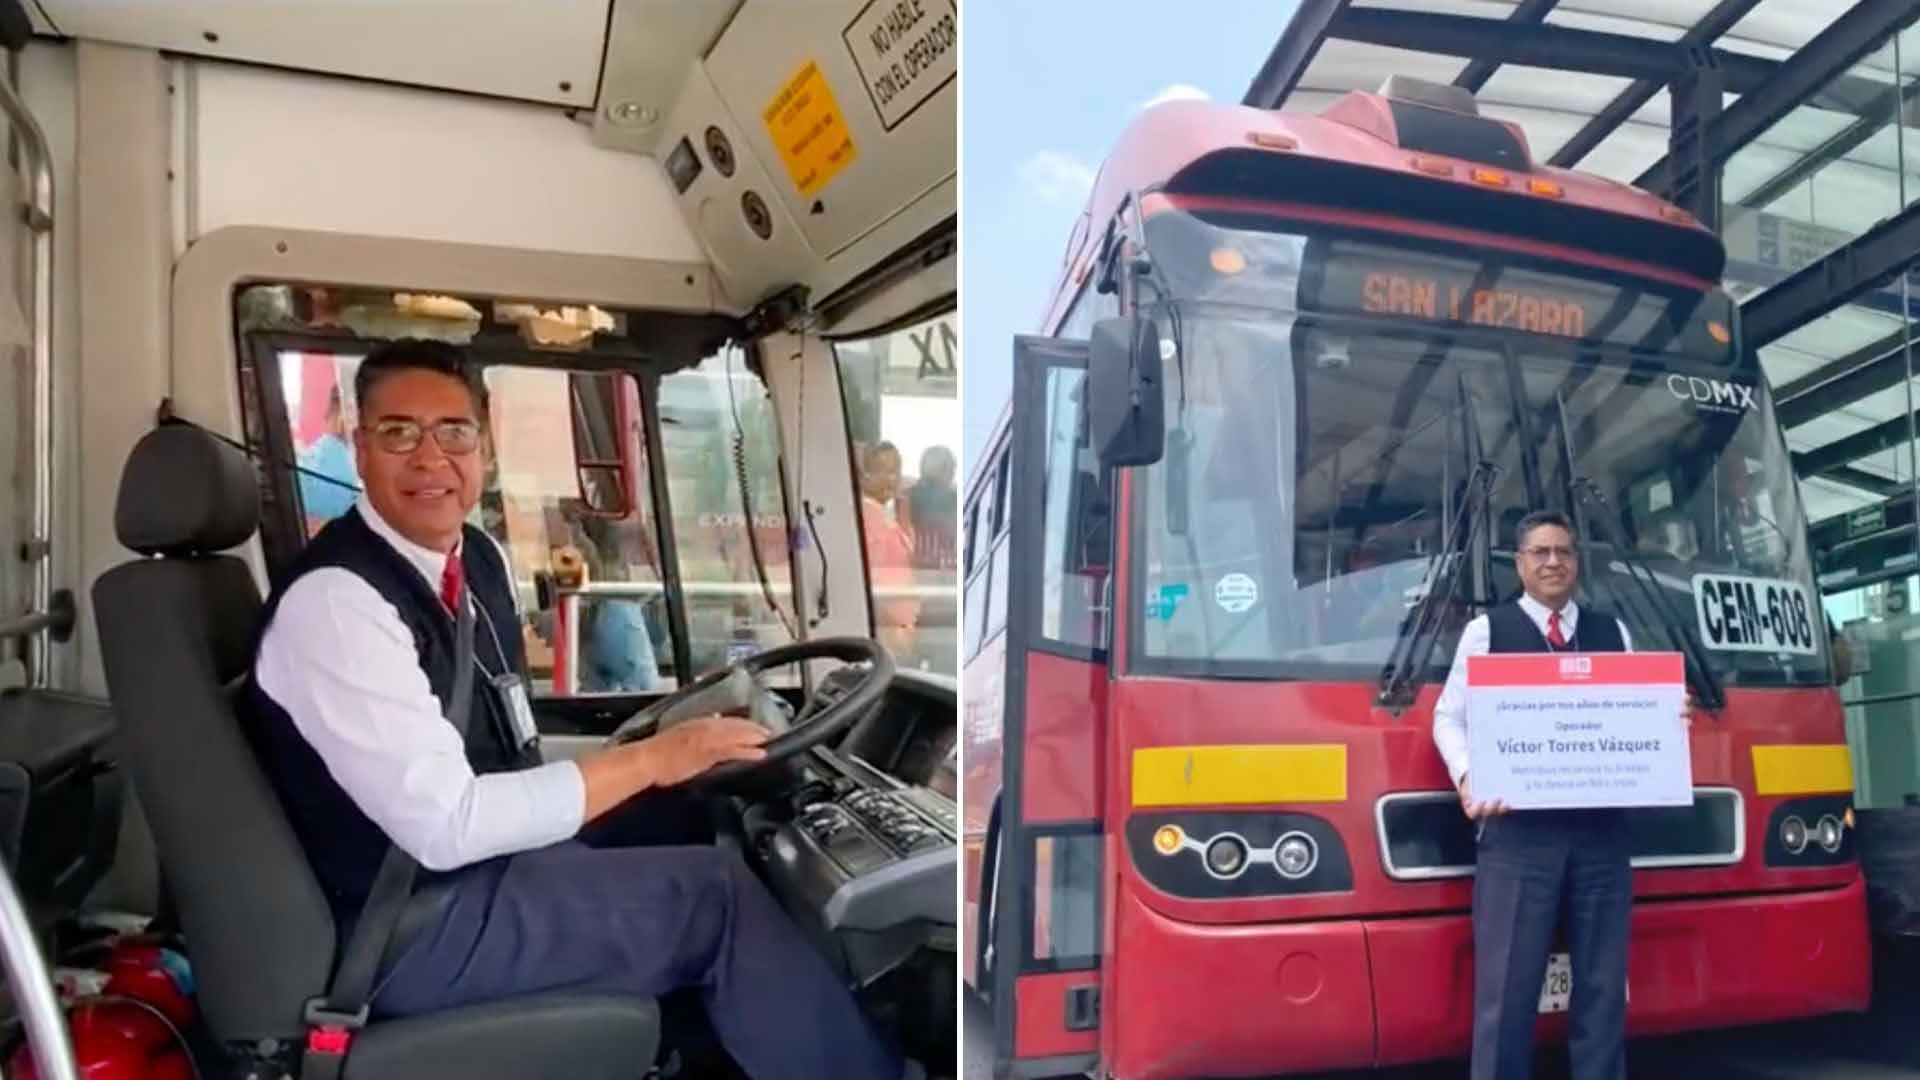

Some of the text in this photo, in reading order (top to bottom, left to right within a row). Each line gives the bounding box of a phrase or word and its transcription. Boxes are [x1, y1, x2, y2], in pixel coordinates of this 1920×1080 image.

[869, 24, 891, 57] NO
[874, 71, 899, 106] CON
[891, 63, 911, 90] EL
[1362, 272, 1438, 320] SAN
[1667, 374, 1759, 411] CDMX
[1701, 579, 1812, 648] CEM-608
[1497, 736, 1661, 755] Víctor Torres Vázquez
